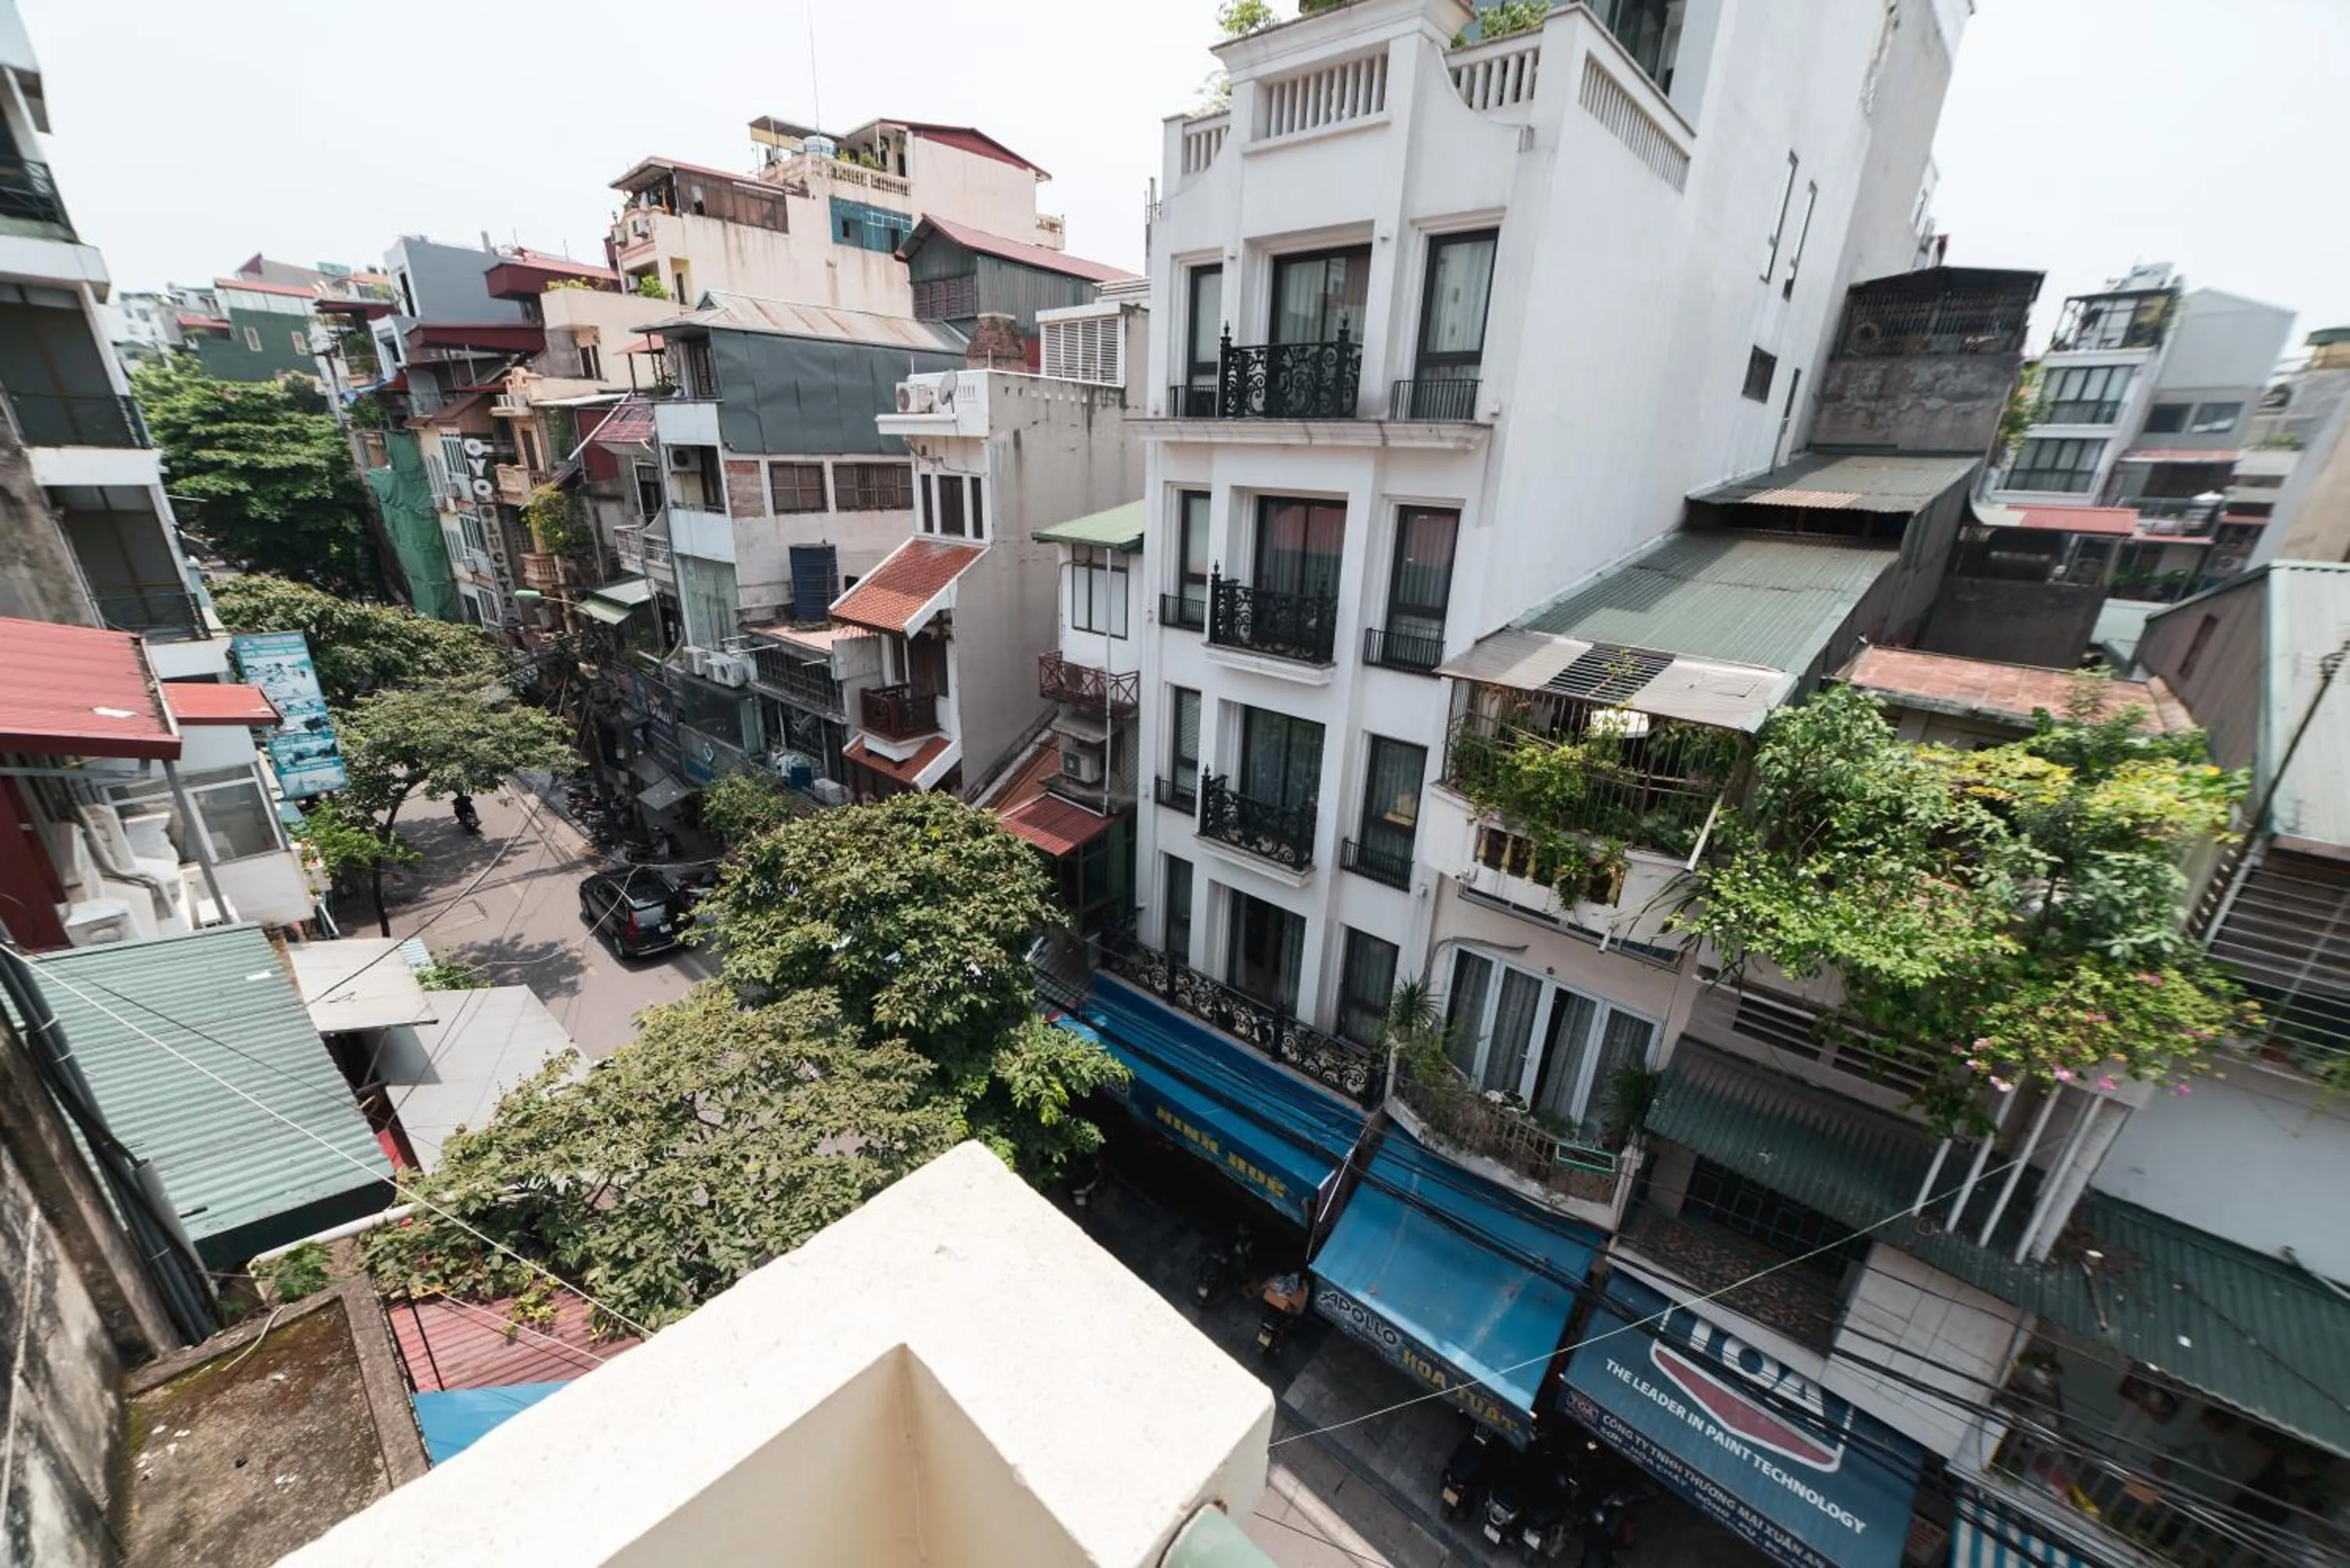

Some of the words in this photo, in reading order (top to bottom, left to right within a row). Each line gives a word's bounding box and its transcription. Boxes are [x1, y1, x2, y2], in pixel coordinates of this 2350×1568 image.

[464, 439, 493, 496] OYO
[1319, 1291, 1397, 1346] APOLLO
[1606, 1357, 1632, 1384] THE
[1632, 1376, 1687, 1420] LEADER
[1687, 1412, 1705, 1432] IN
[1705, 1424, 1752, 1461] PAINT
[1752, 1454, 1867, 1534] TECHNOLOGY
